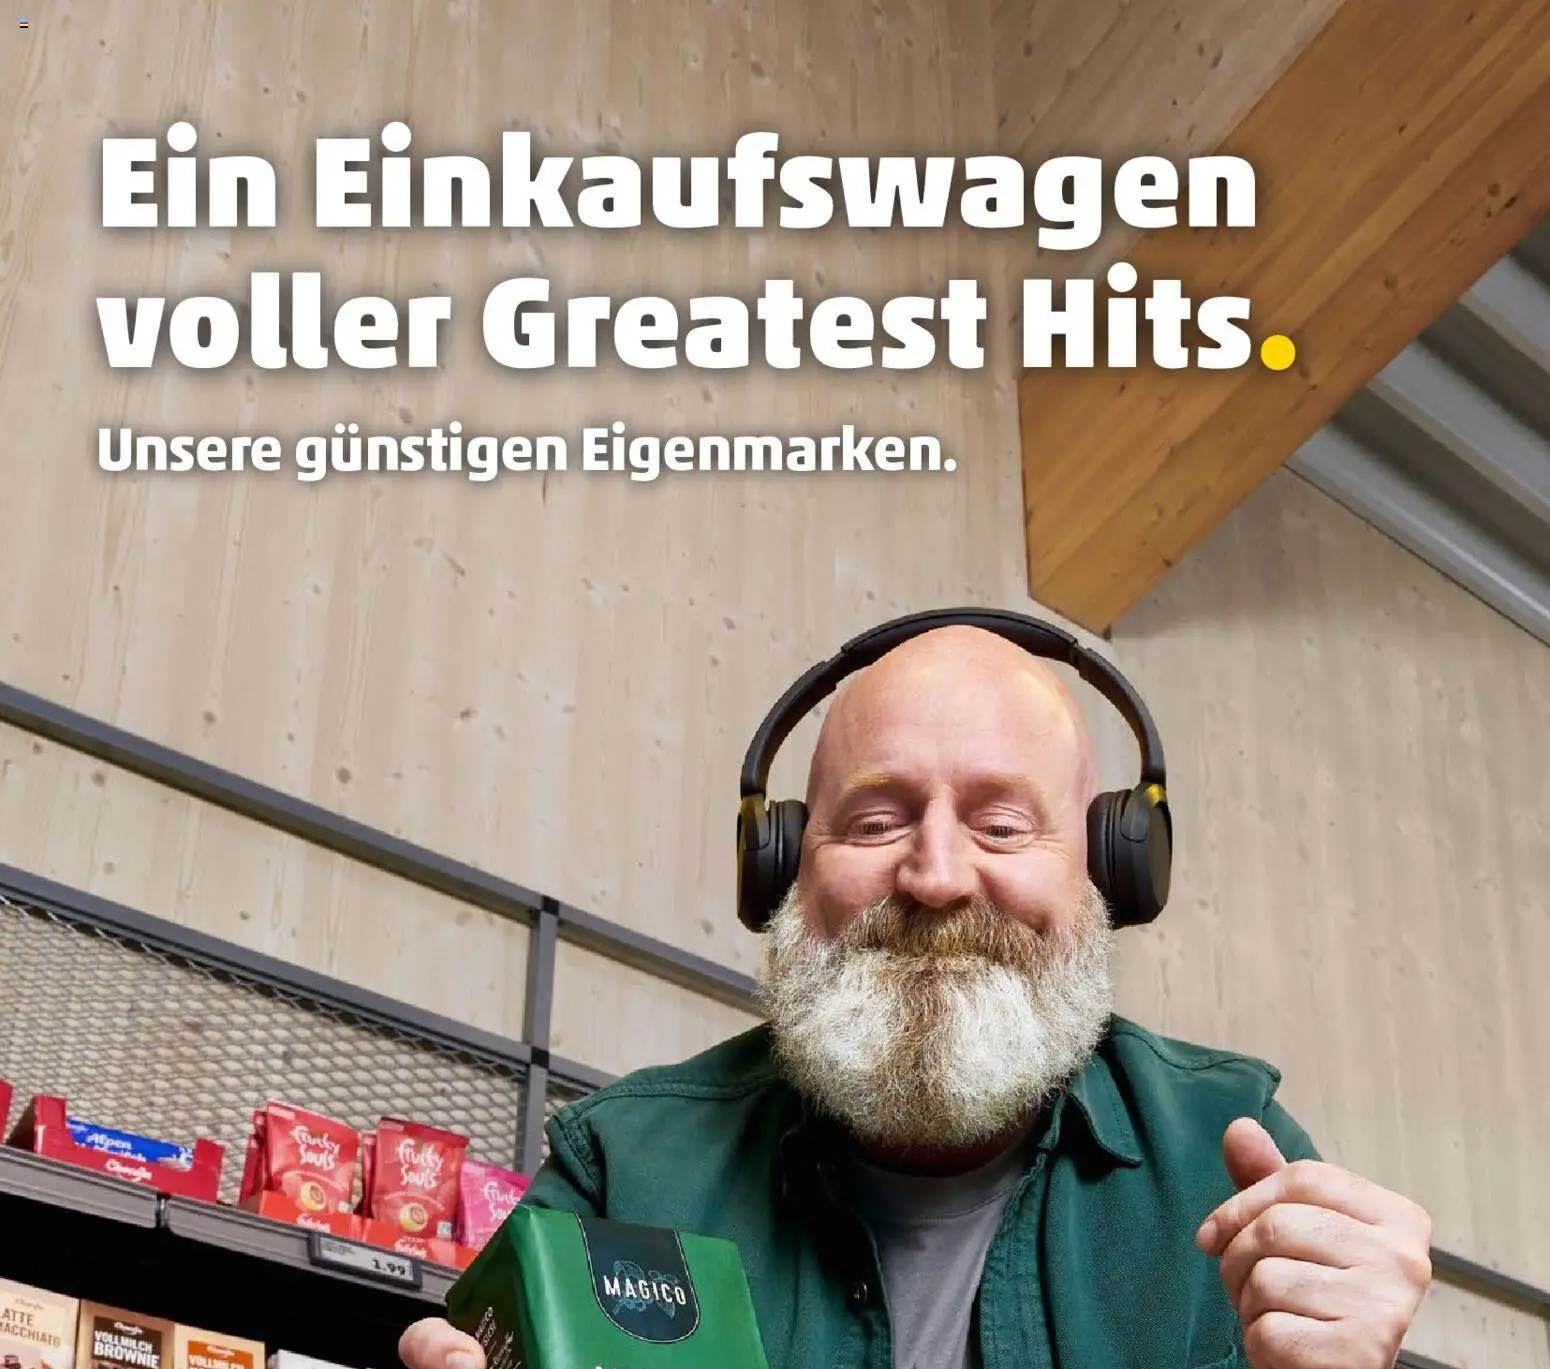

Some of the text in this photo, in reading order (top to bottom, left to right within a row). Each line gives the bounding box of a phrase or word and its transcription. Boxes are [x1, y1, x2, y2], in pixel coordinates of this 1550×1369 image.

[372, 1256, 406, 1275] 1.99
[603, 1273, 687, 1307] MAGICO
[1, 1308, 34, 1327] ATTE
[94, 1330, 153, 1354] VOLLMILCH
[94, 1341, 160, 1369] BROWNIE
